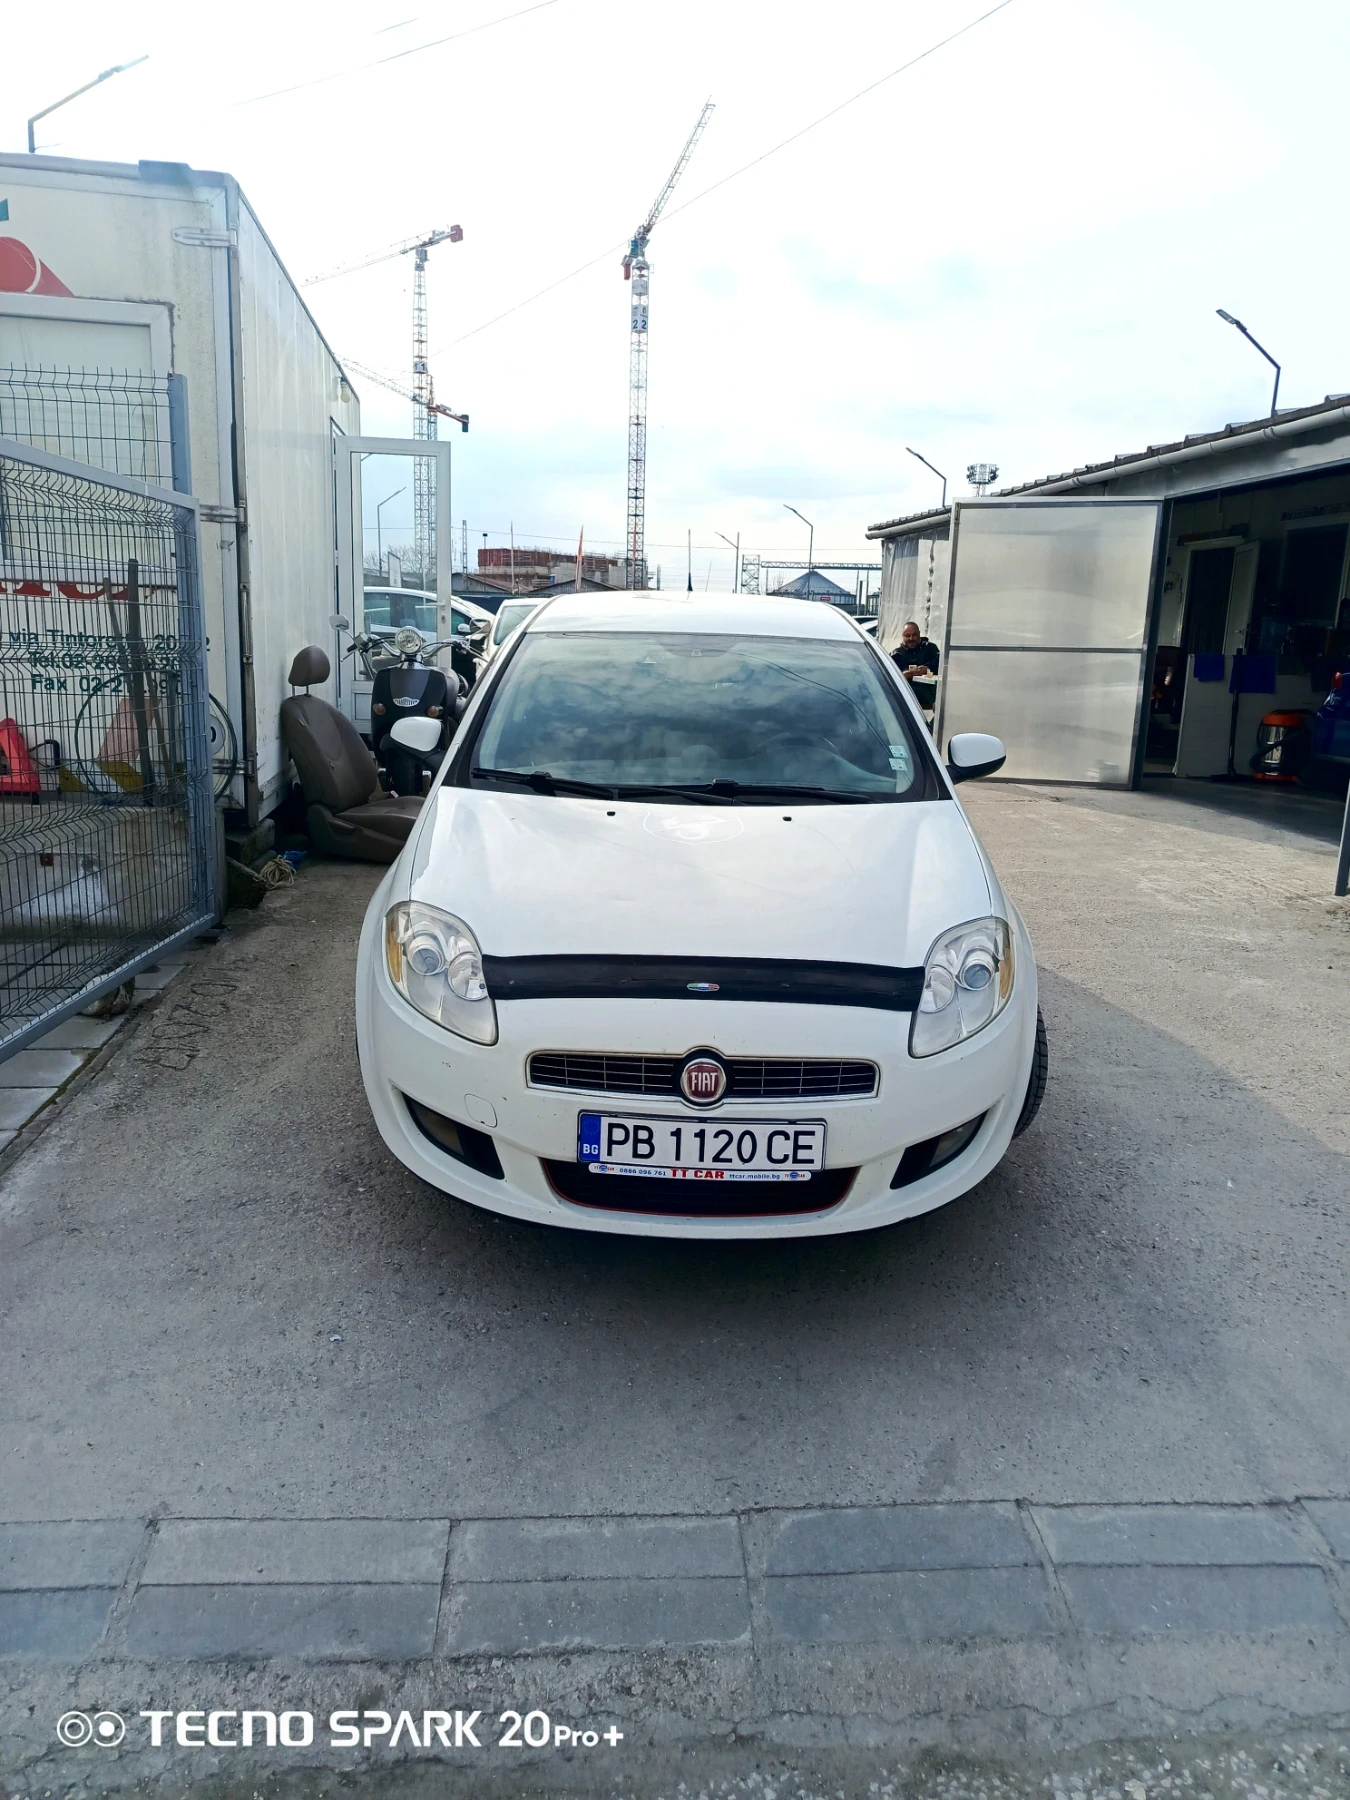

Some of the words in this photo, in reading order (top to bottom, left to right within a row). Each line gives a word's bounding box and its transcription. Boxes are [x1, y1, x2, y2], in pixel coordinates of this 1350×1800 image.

[641, 320, 646, 330] 2
[31, 674, 68, 691] Fax
[690, 1072, 718, 1092] FIAT
[583, 1144, 598, 1154] BG
[607, 1122, 655, 1159] PB
[670, 1128, 757, 1164] 1120
[766, 1130, 815, 1164] CE
[671, 1168, 688, 1178] TT
[694, 1170, 724, 1178] CAR
